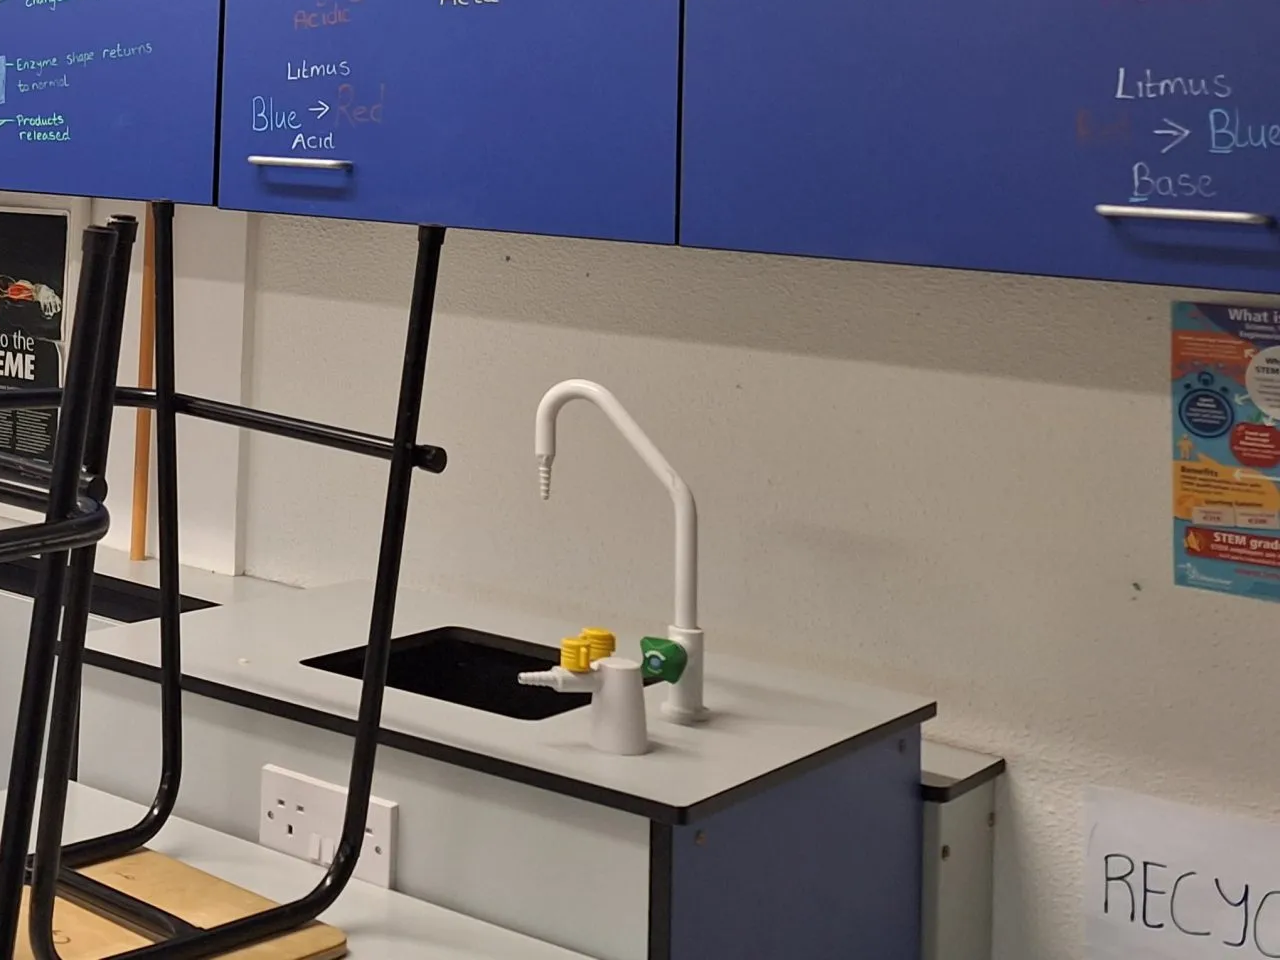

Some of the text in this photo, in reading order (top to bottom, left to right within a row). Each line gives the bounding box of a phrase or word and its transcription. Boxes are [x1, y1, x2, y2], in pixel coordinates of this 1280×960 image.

[16, 56, 58, 77] Enzyme
[102, 42, 153, 59] returns
[287, 59, 351, 81] Litmus
[17, 74, 70, 93] to normal
[1114, 67, 1232, 99] Litmus
[16, 112, 64, 127] Products
[252, 96, 302, 132] Blue
[19, 125, 71, 141] released
[1209, 106, 1280, 150] Blue
[291, 132, 336, 150] Acid
[1131, 162, 1217, 198] Base
[1228, 307, 1268, 324] What
[12, 331, 35, 352] the
[1213, 531, 1247, 546] STEM
